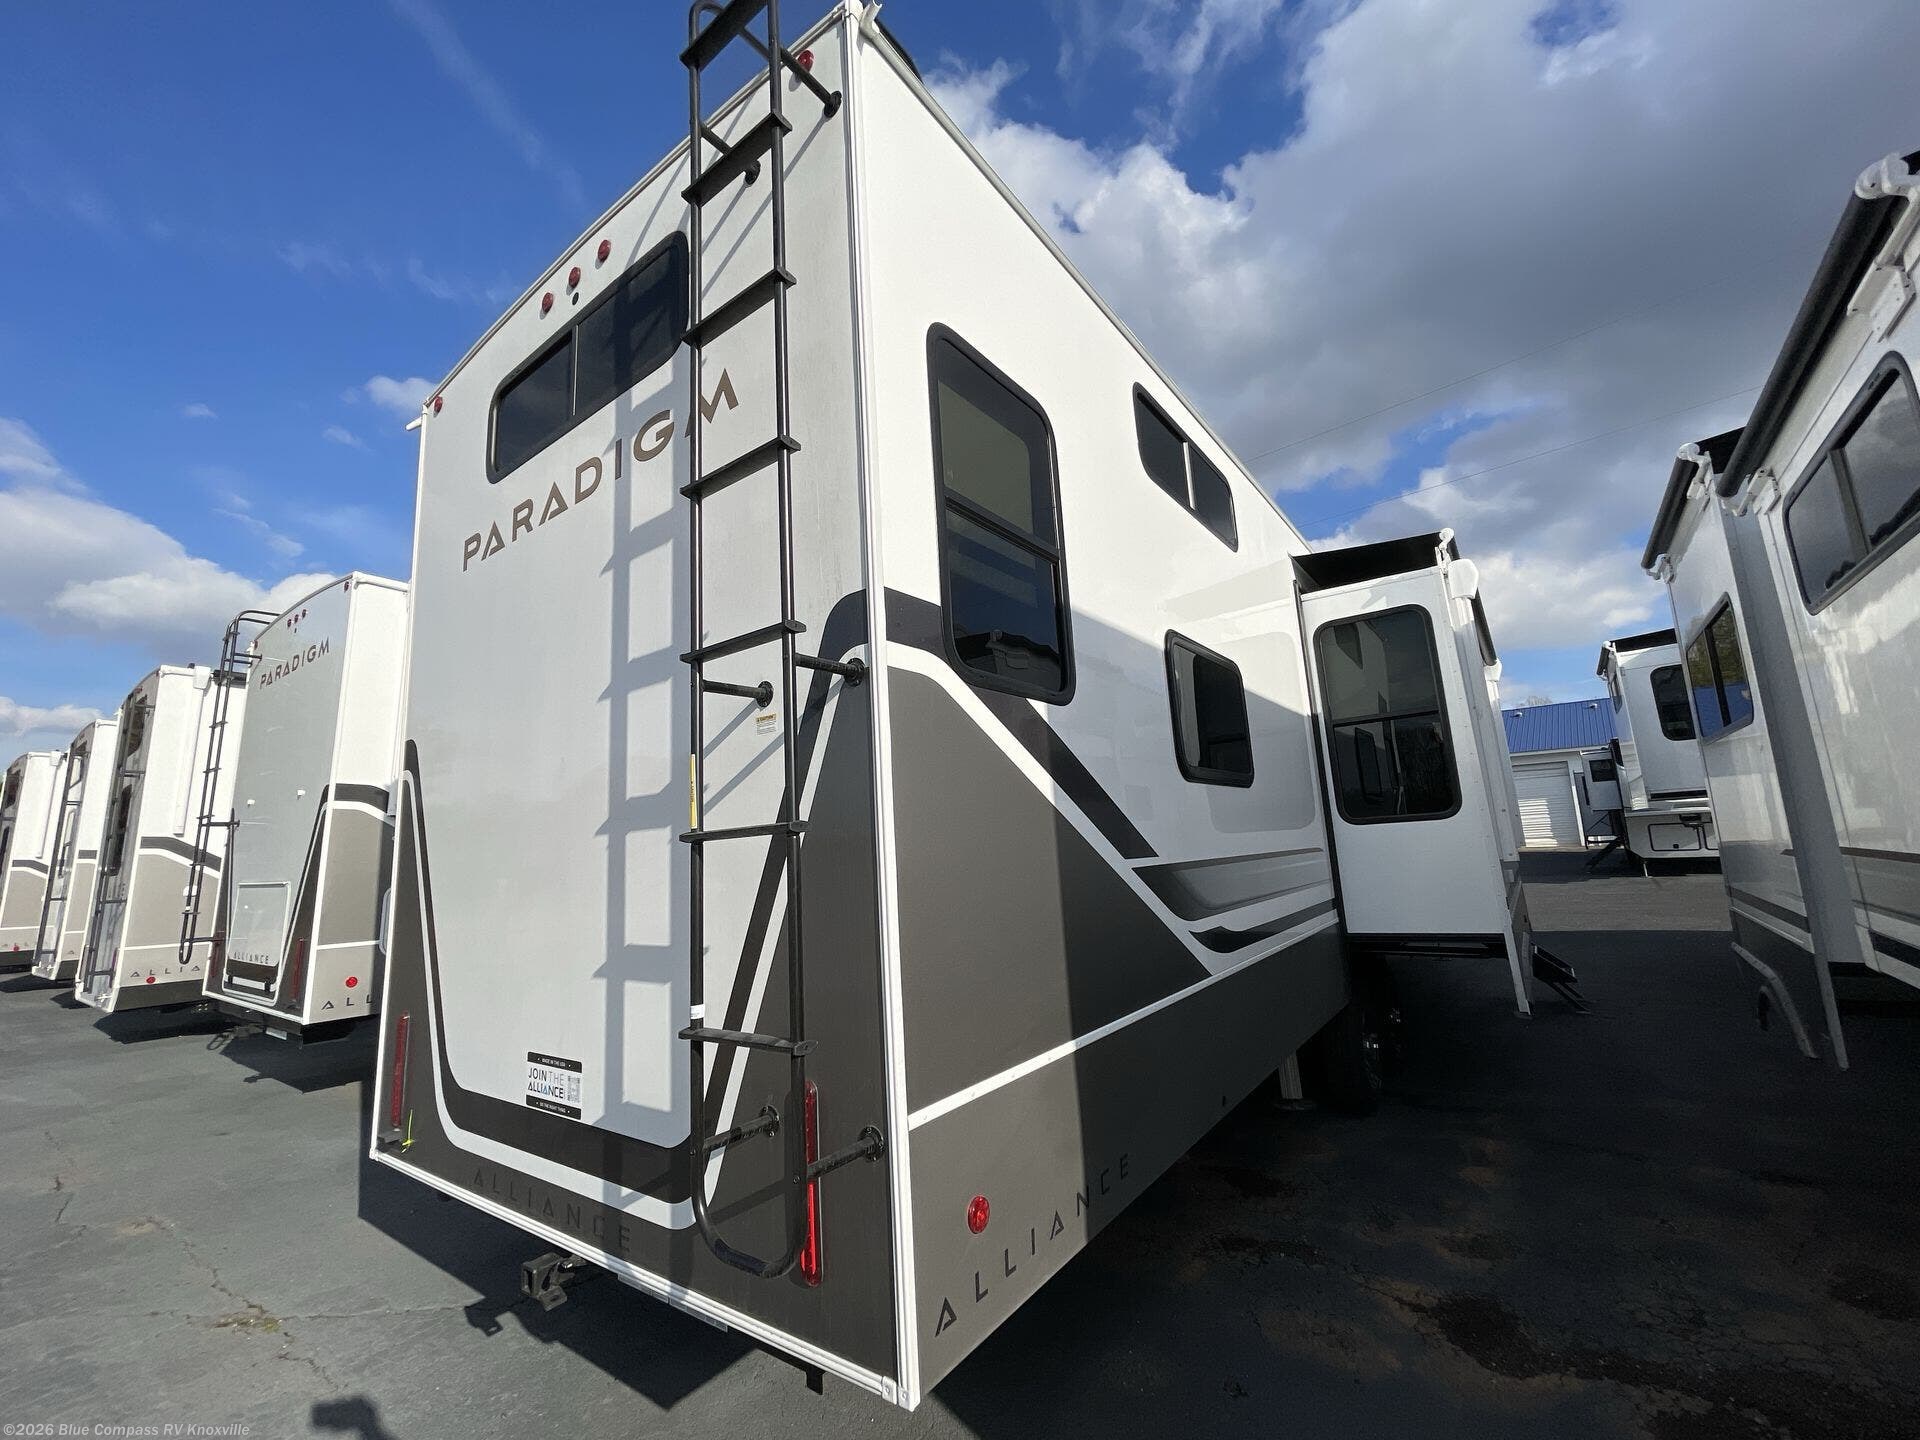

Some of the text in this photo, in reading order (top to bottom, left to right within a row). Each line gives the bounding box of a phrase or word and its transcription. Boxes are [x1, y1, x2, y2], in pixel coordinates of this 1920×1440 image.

[463, 367, 738, 573] PARADIGM
[260, 636, 329, 689] PARADIGM
[233, 951, 269, 964] ALLIANCE
[528, 1067, 564, 1087] JOIN THE
[528, 1082, 564, 1099] ALLIANCE
[473, 1168, 631, 1254] ALLIANCE
[934, 1153, 1129, 1338] ALLIANCE
